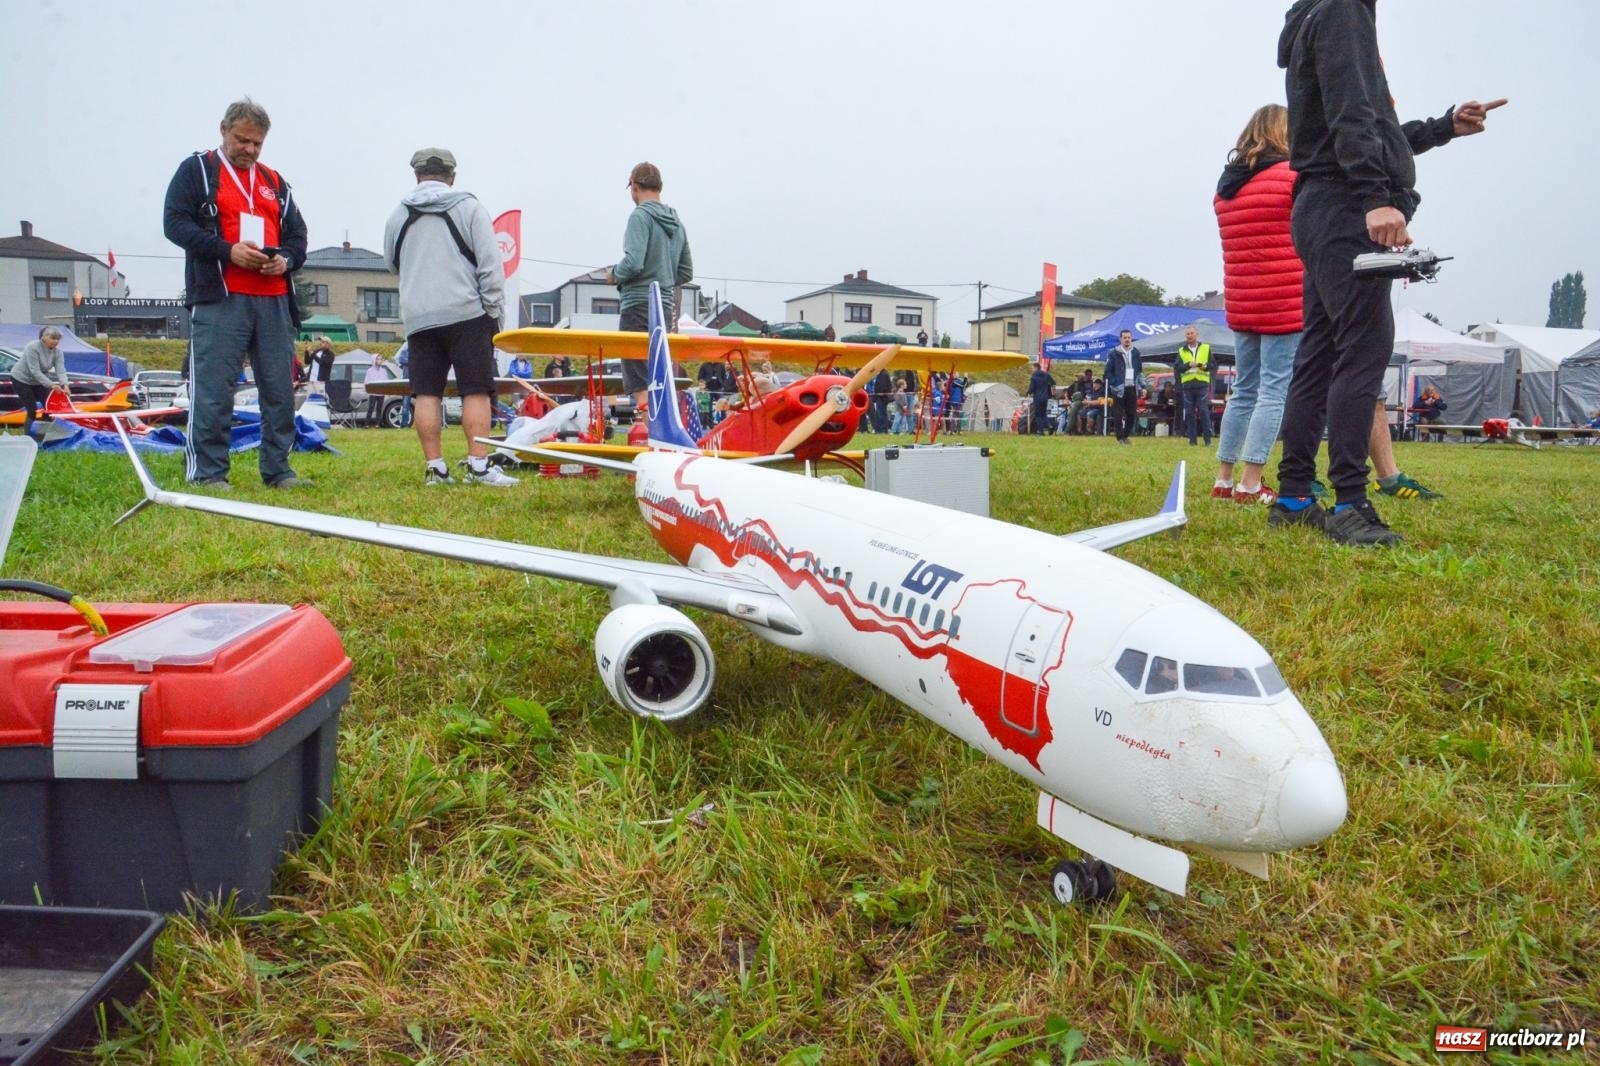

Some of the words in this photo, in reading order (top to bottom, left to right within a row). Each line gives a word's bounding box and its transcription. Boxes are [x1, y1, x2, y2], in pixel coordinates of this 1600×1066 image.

[84, 298, 109, 306] LODY
[112, 299, 151, 307] GRANITY
[901, 559, 965, 600] LOT
[1094, 706, 1113, 727] VD
